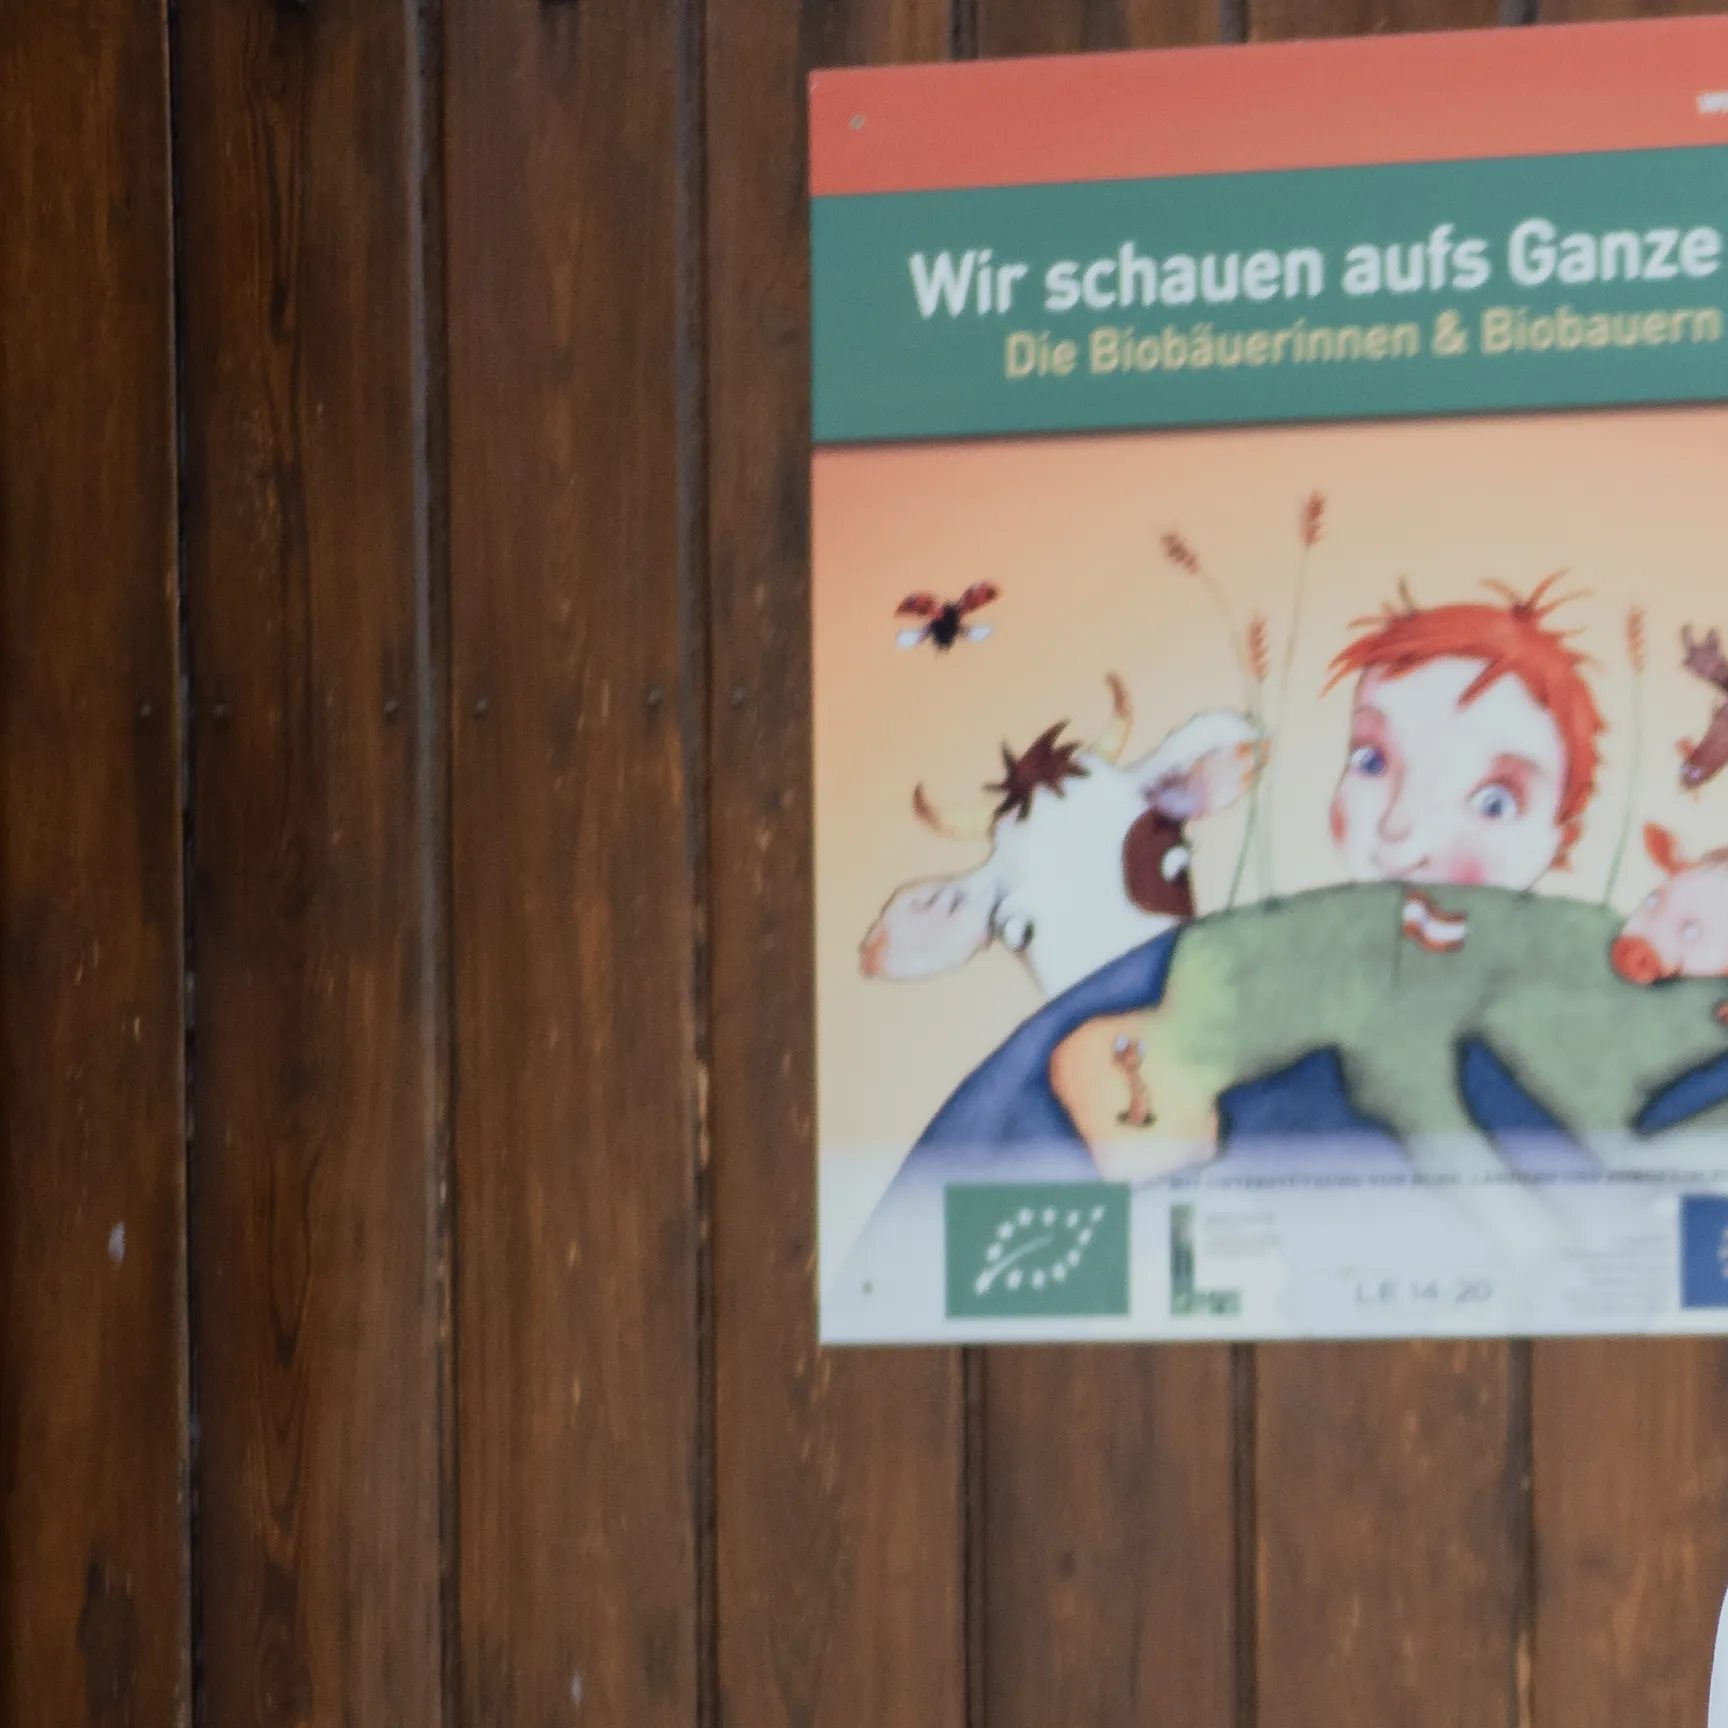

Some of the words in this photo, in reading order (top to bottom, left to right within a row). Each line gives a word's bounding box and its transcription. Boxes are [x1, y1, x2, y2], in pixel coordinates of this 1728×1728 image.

[909, 248, 1029, 318] Wir
[1044, 240, 1325, 312] schauen
[1342, 222, 1491, 295] aufs
[1508, 217, 1722, 286] Ganze
[1005, 330, 1080, 379] Die
[1090, 317, 1419, 375] Biobäuerinnen
[1431, 308, 1468, 356] &
[1481, 304, 1722, 354] Biobauern
